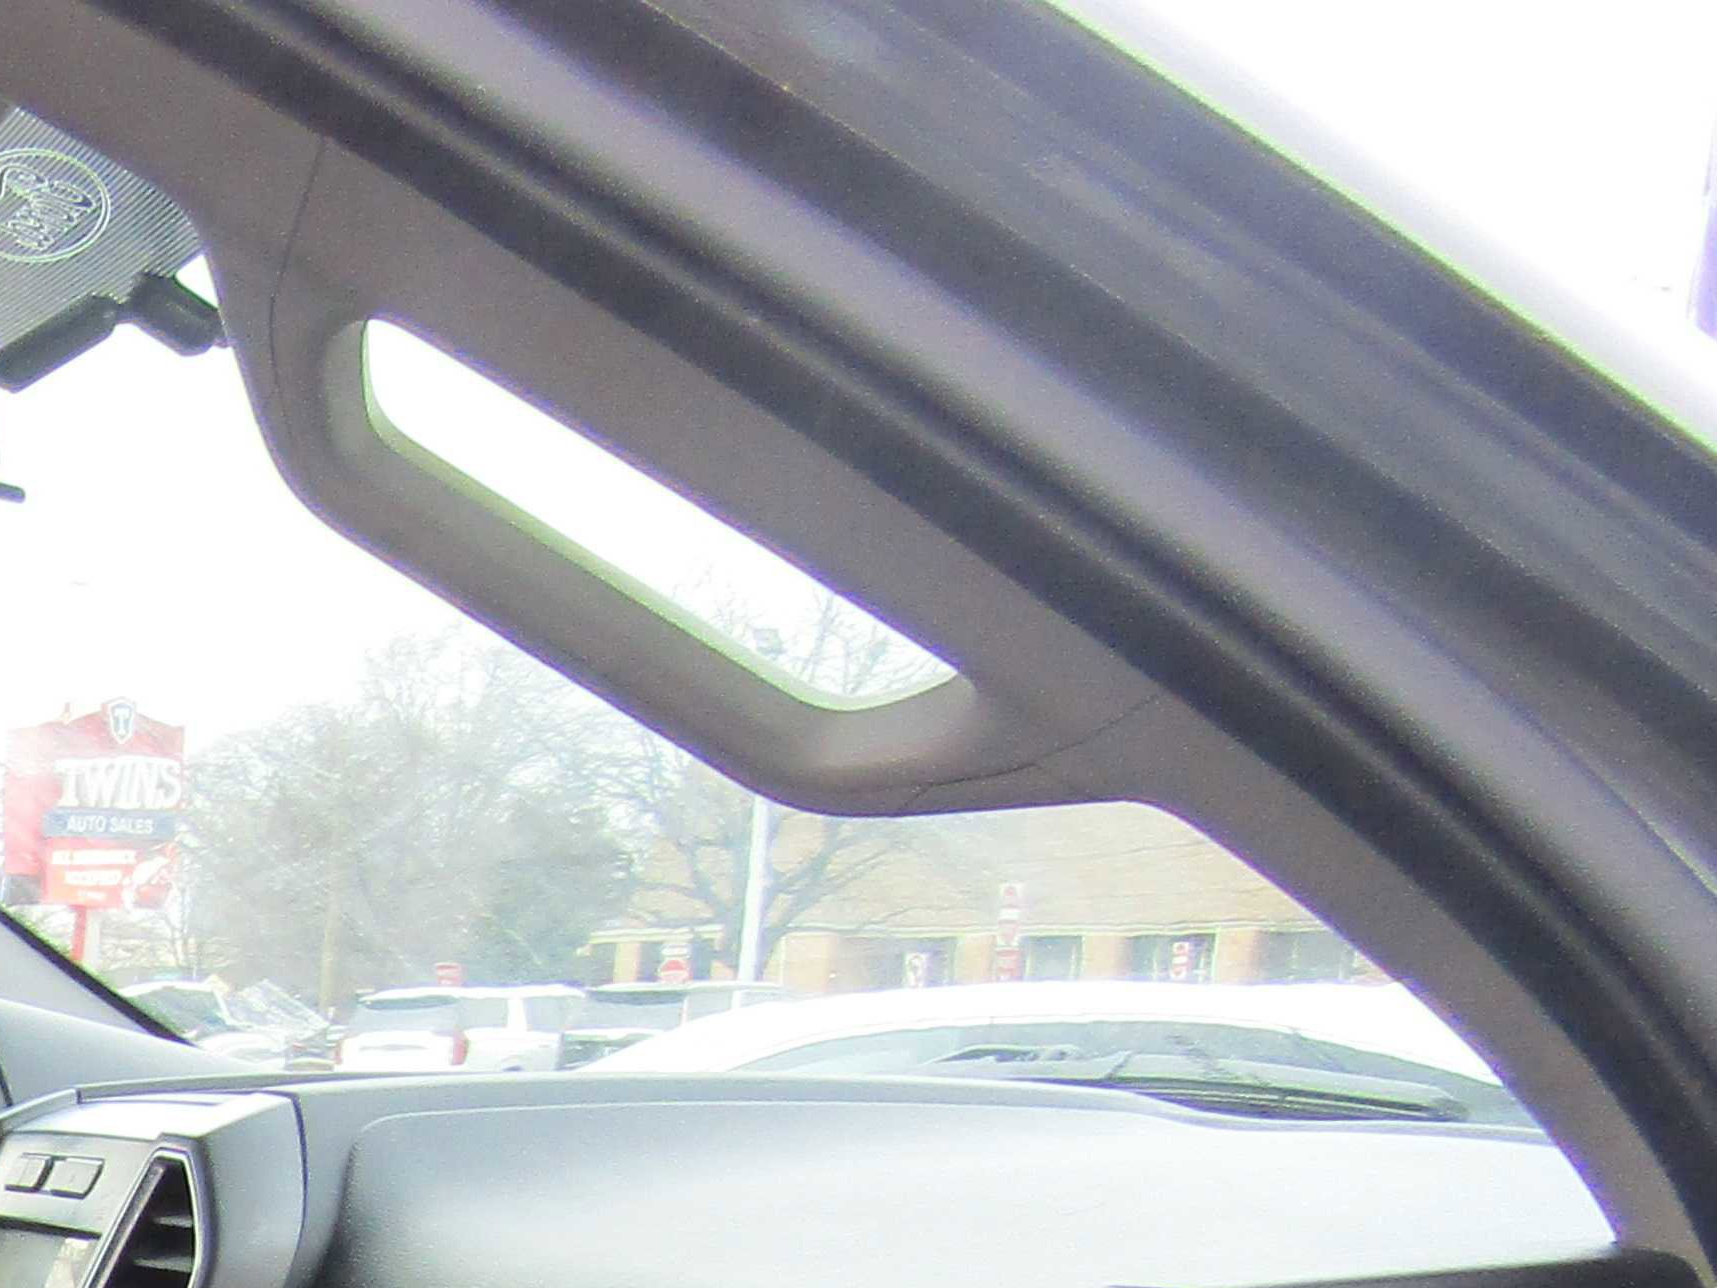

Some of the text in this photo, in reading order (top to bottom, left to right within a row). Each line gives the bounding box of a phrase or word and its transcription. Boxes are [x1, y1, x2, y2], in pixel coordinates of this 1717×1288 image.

[53, 757, 182, 809] TWINS
[67, 815, 153, 834] AUTO SALES
